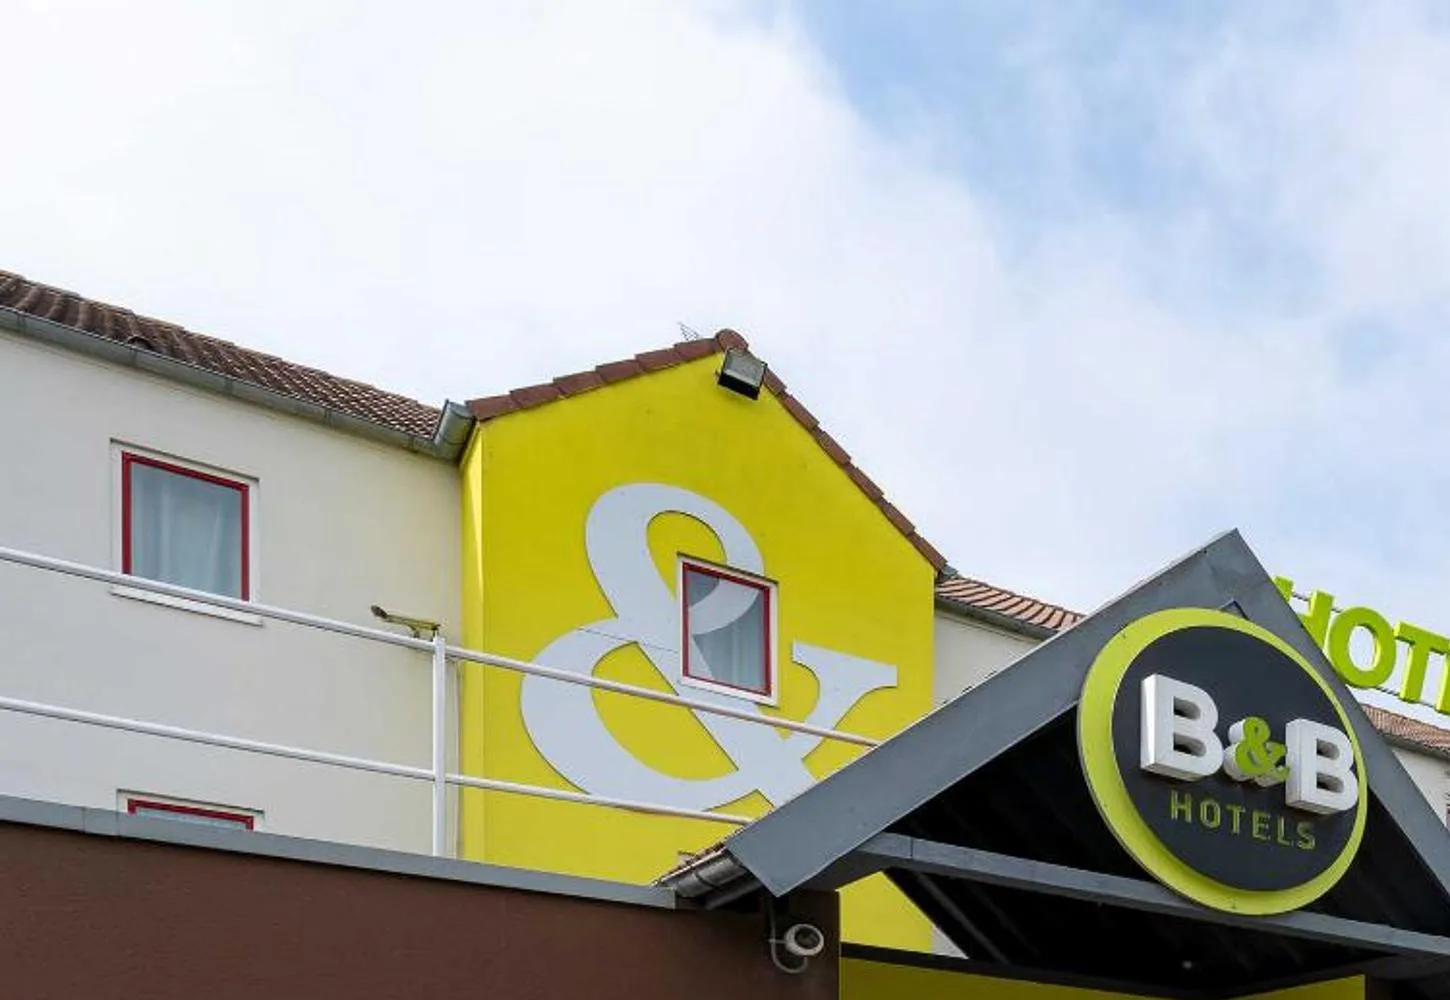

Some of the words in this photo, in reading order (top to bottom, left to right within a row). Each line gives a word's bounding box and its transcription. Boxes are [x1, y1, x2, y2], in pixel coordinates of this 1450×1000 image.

[521, 481, 897, 812] &
[1141, 674, 1359, 815] B&B
[1169, 790, 1316, 850] HOTELS
